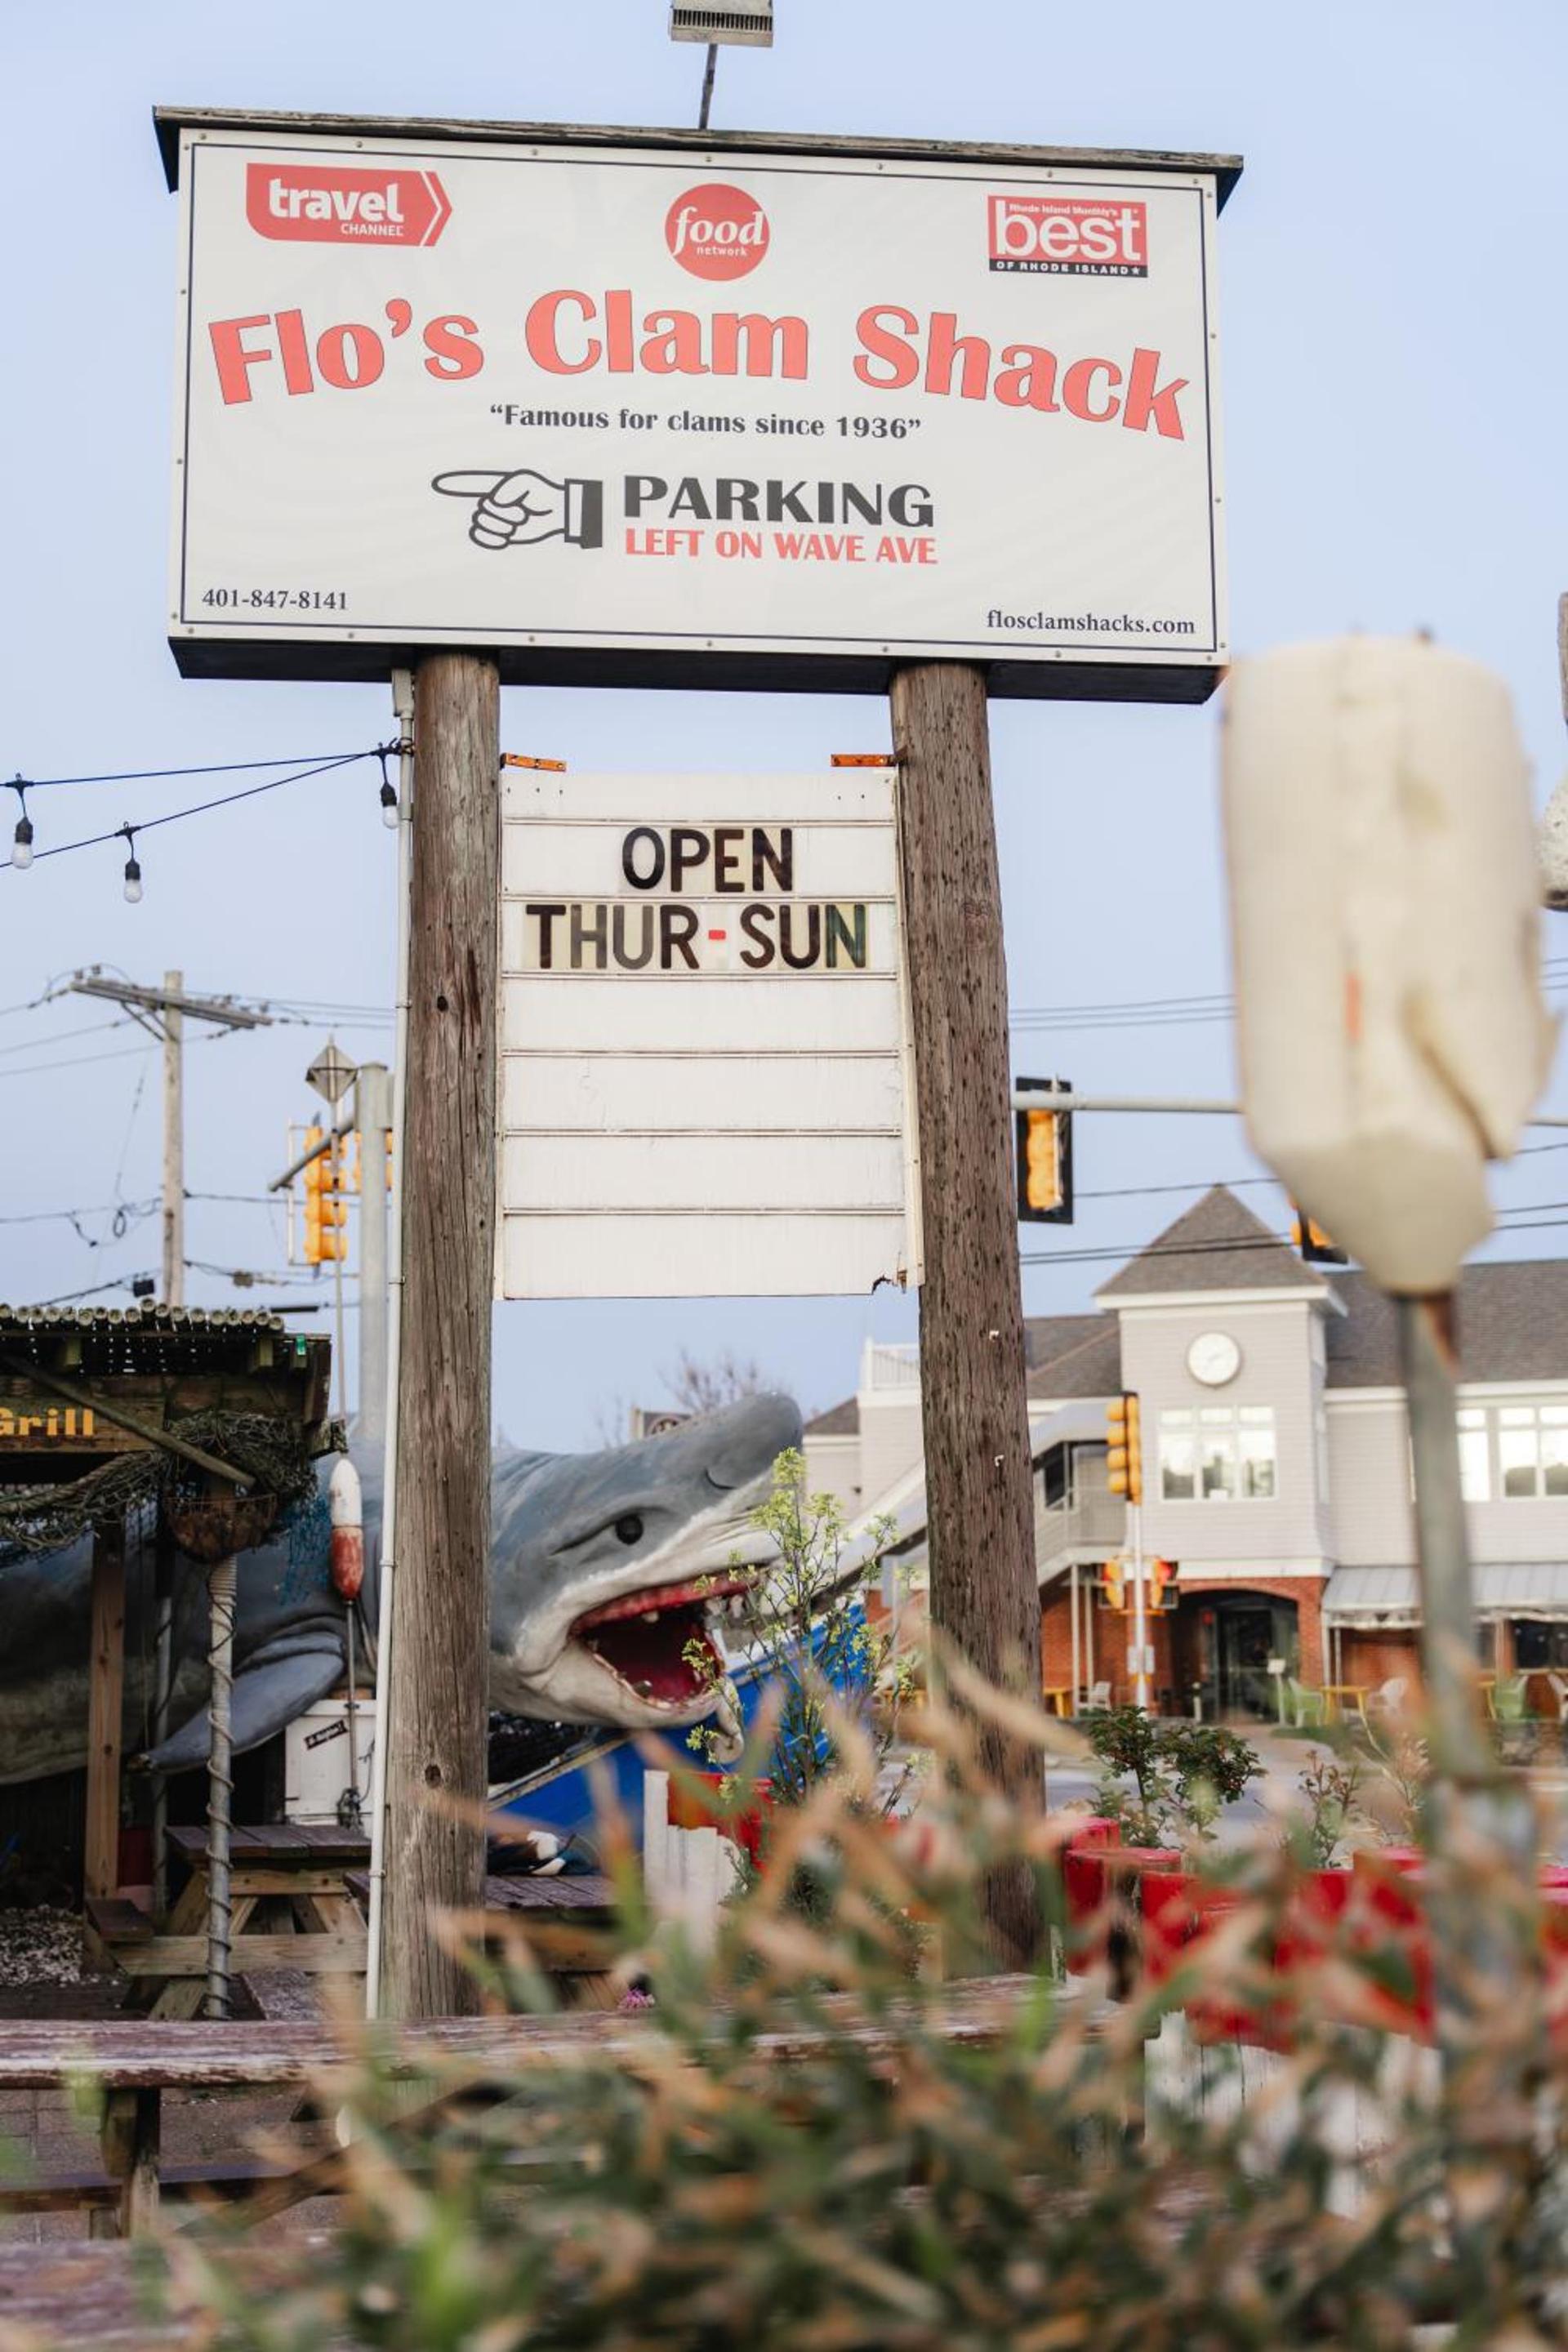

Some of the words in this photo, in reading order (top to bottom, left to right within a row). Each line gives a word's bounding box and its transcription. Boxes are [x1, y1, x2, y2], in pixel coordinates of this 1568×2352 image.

[269, 177, 404, 223] travel
[341, 223, 404, 237] CHANNEL
[671, 205, 766, 257] food
[995, 200, 1141, 261] best
[696, 247, 748, 257] network
[996, 261, 1014, 270] OF
[1020, 262, 1069, 273] RHODE
[1075, 265, 1129, 275] ISLAND
[207, 297, 484, 405] Flo’s
[524, 288, 809, 381] Clam
[853, 304, 1191, 442] Shack
[619, 408, 658, 430] for
[667, 410, 746, 433] clams
[755, 413, 825, 436] since
[623, 474, 934, 528] PARKING
[626, 527, 705, 557] LEFT
[715, 530, 762, 559] ON
[773, 532, 866, 562] WAVE
[875, 536, 938, 565] AVE
[202, 588, 348, 610] 401-847-8141
[986, 609, 1196, 635] flosclamshacks.com
[621, 826, 793, 893] OPEN
[525, 902, 867, 970] THUR-SUN
